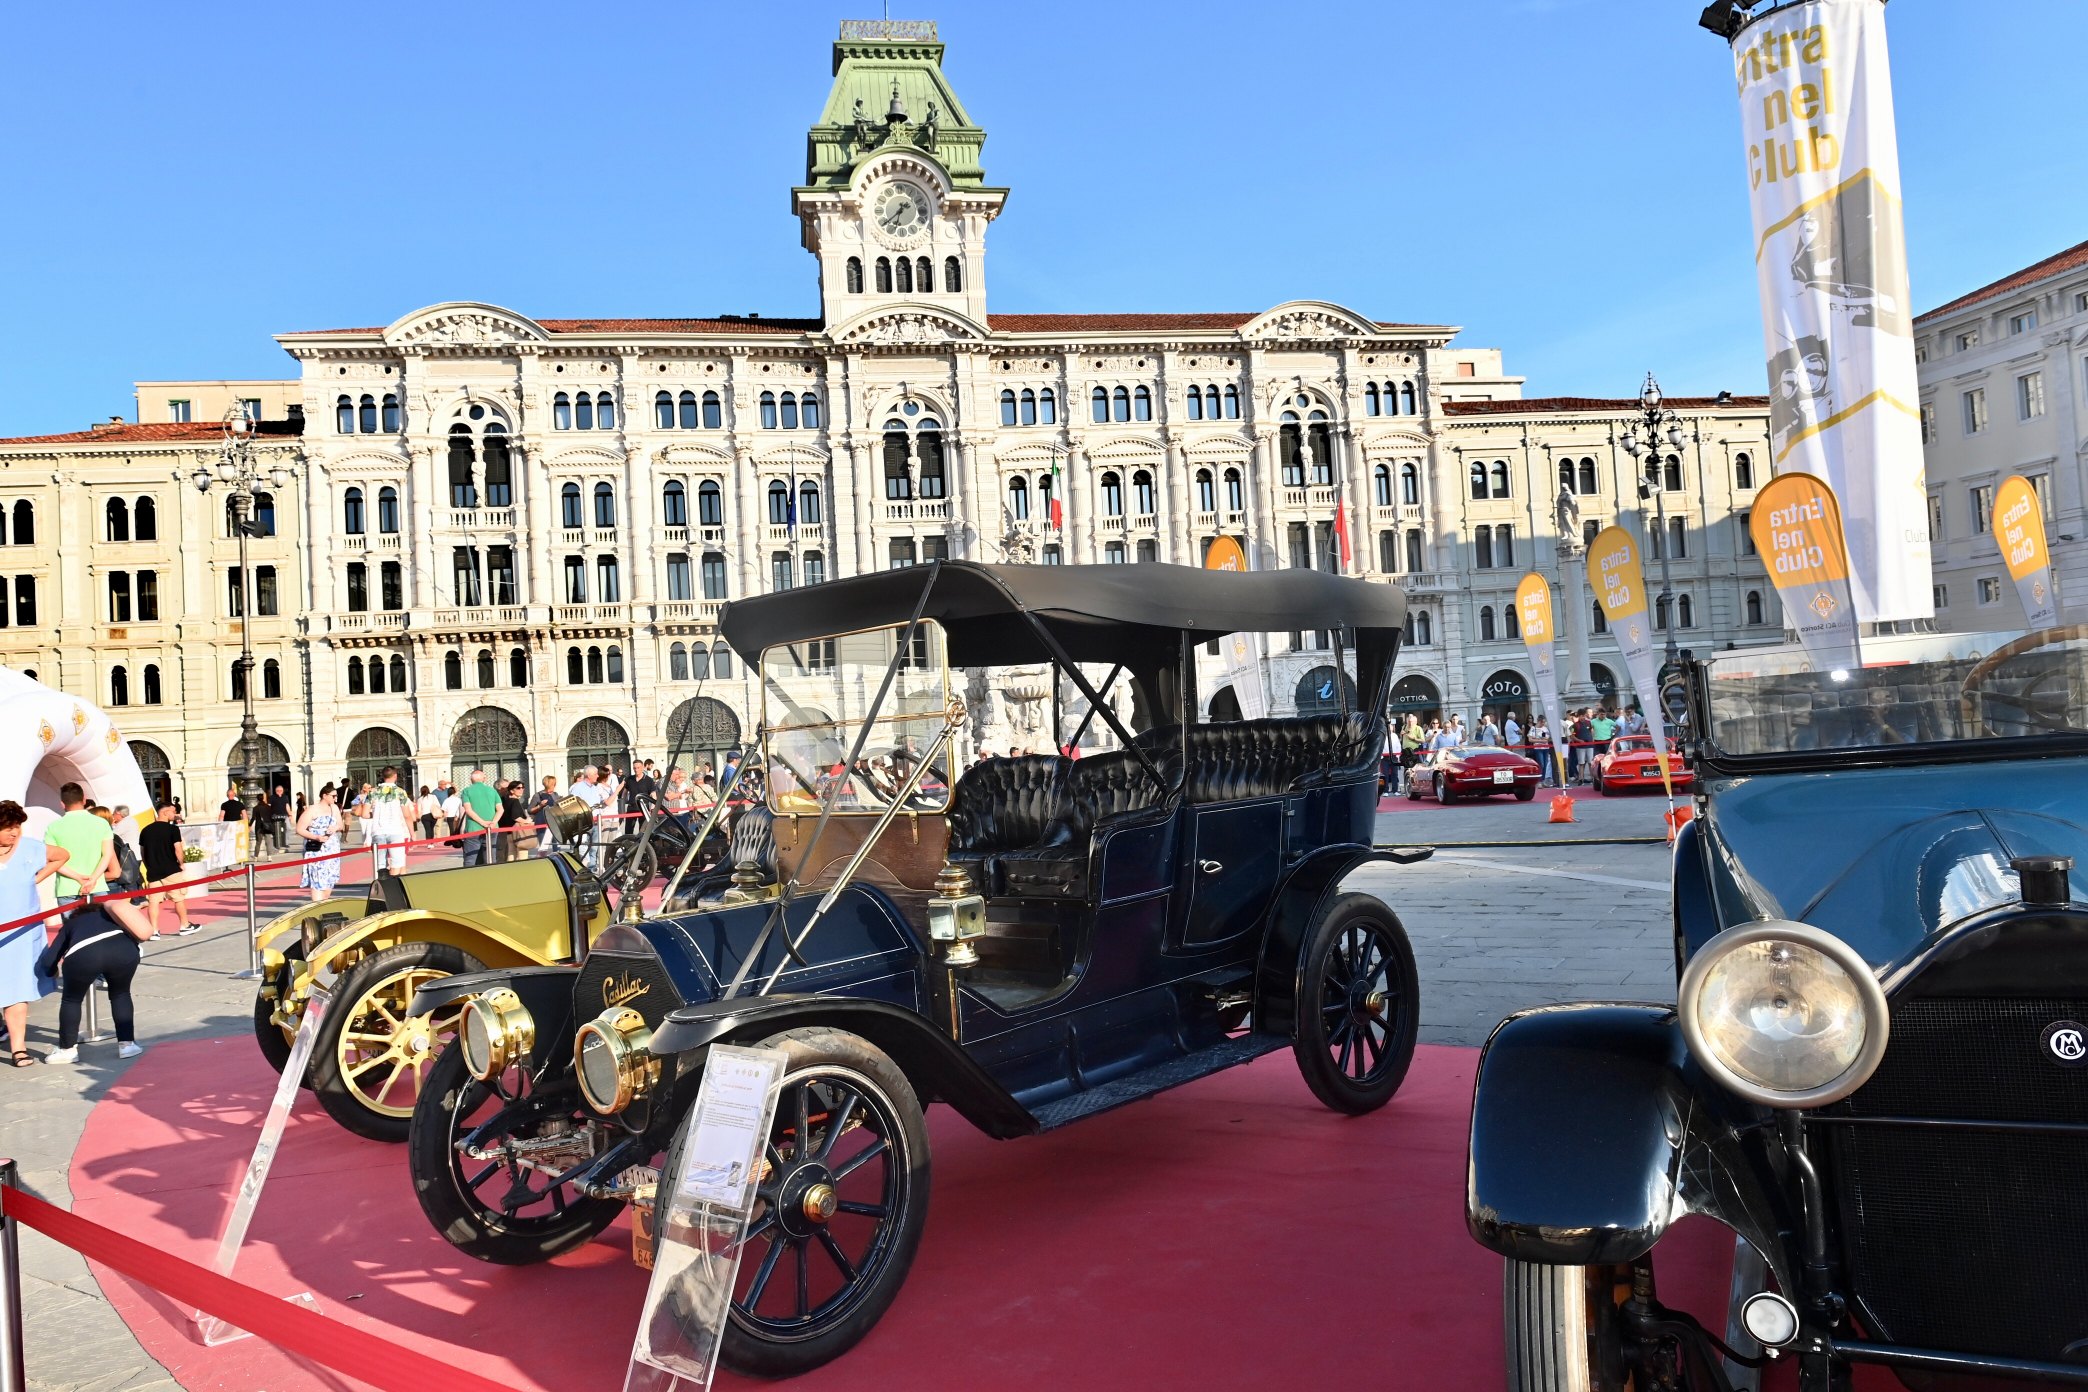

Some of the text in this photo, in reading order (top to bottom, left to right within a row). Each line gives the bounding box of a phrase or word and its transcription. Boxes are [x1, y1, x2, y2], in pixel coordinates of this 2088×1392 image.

[1736, 24, 1829, 98] ntra
[1764, 67, 1834, 130] nel
[1400, 694, 1428, 702] OTTICA
[1486, 681, 1521, 696] FOTO
[602, 969, 650, 1008] Cadillac
